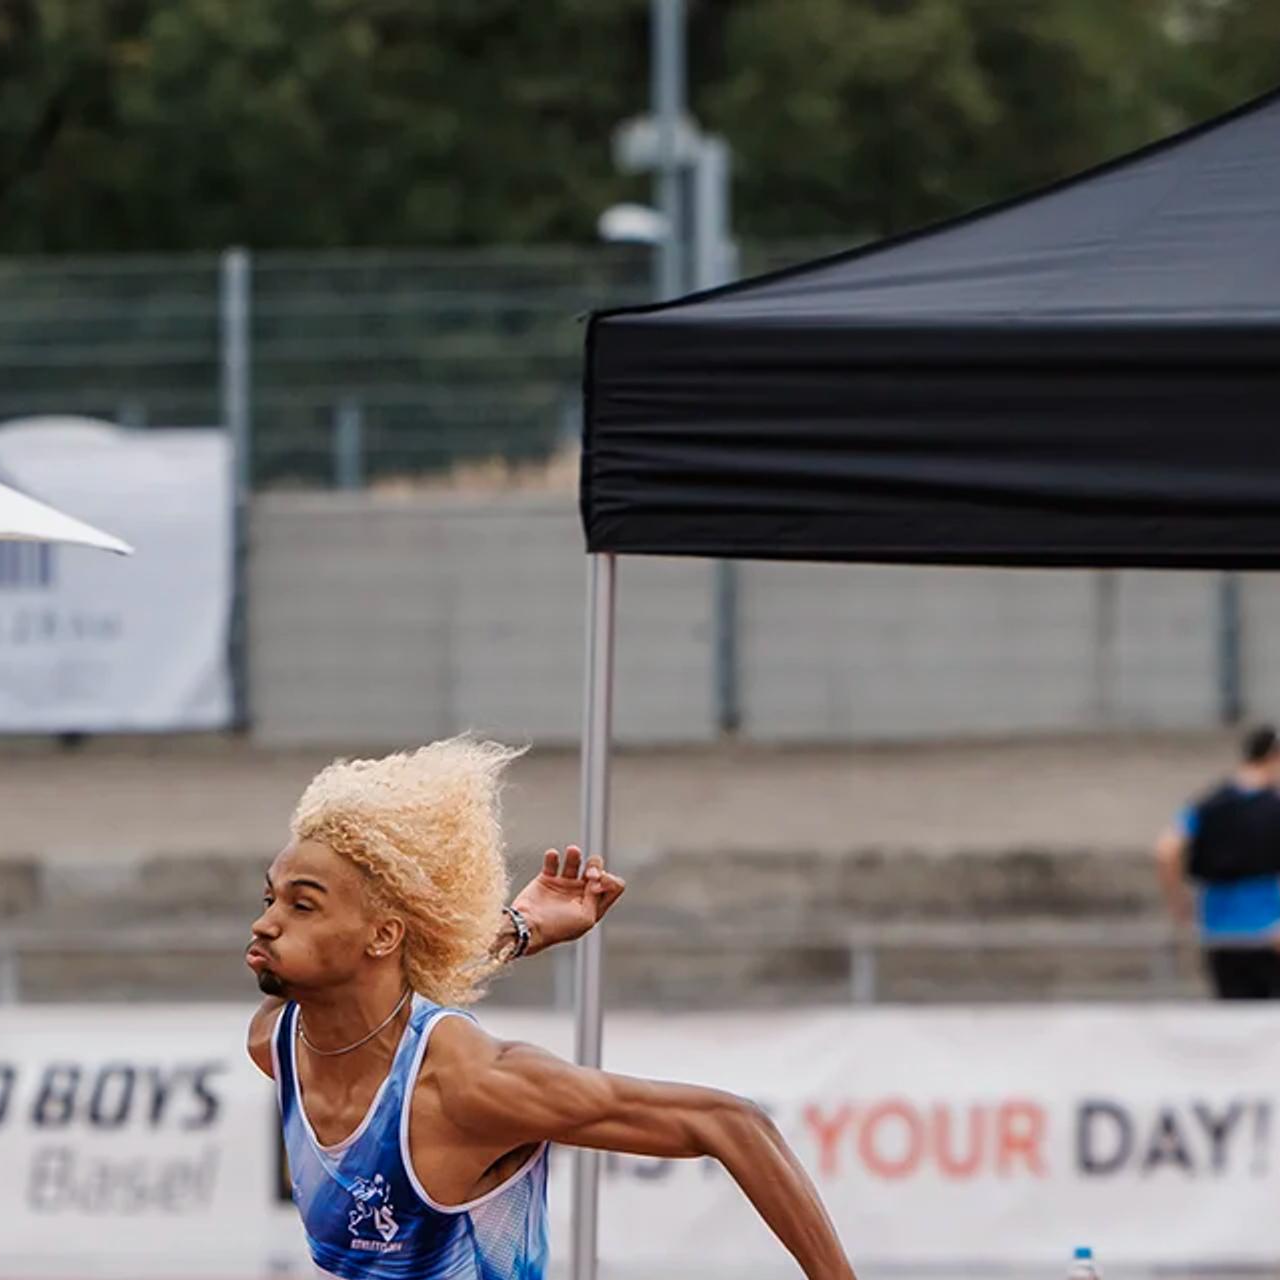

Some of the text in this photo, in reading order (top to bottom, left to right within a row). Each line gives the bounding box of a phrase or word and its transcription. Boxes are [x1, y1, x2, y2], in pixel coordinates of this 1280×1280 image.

[31, 1061, 230, 1131] BOYS
[801, 1099, 1048, 1179] YOUR
[1076, 1101, 1273, 1178] DAY!
